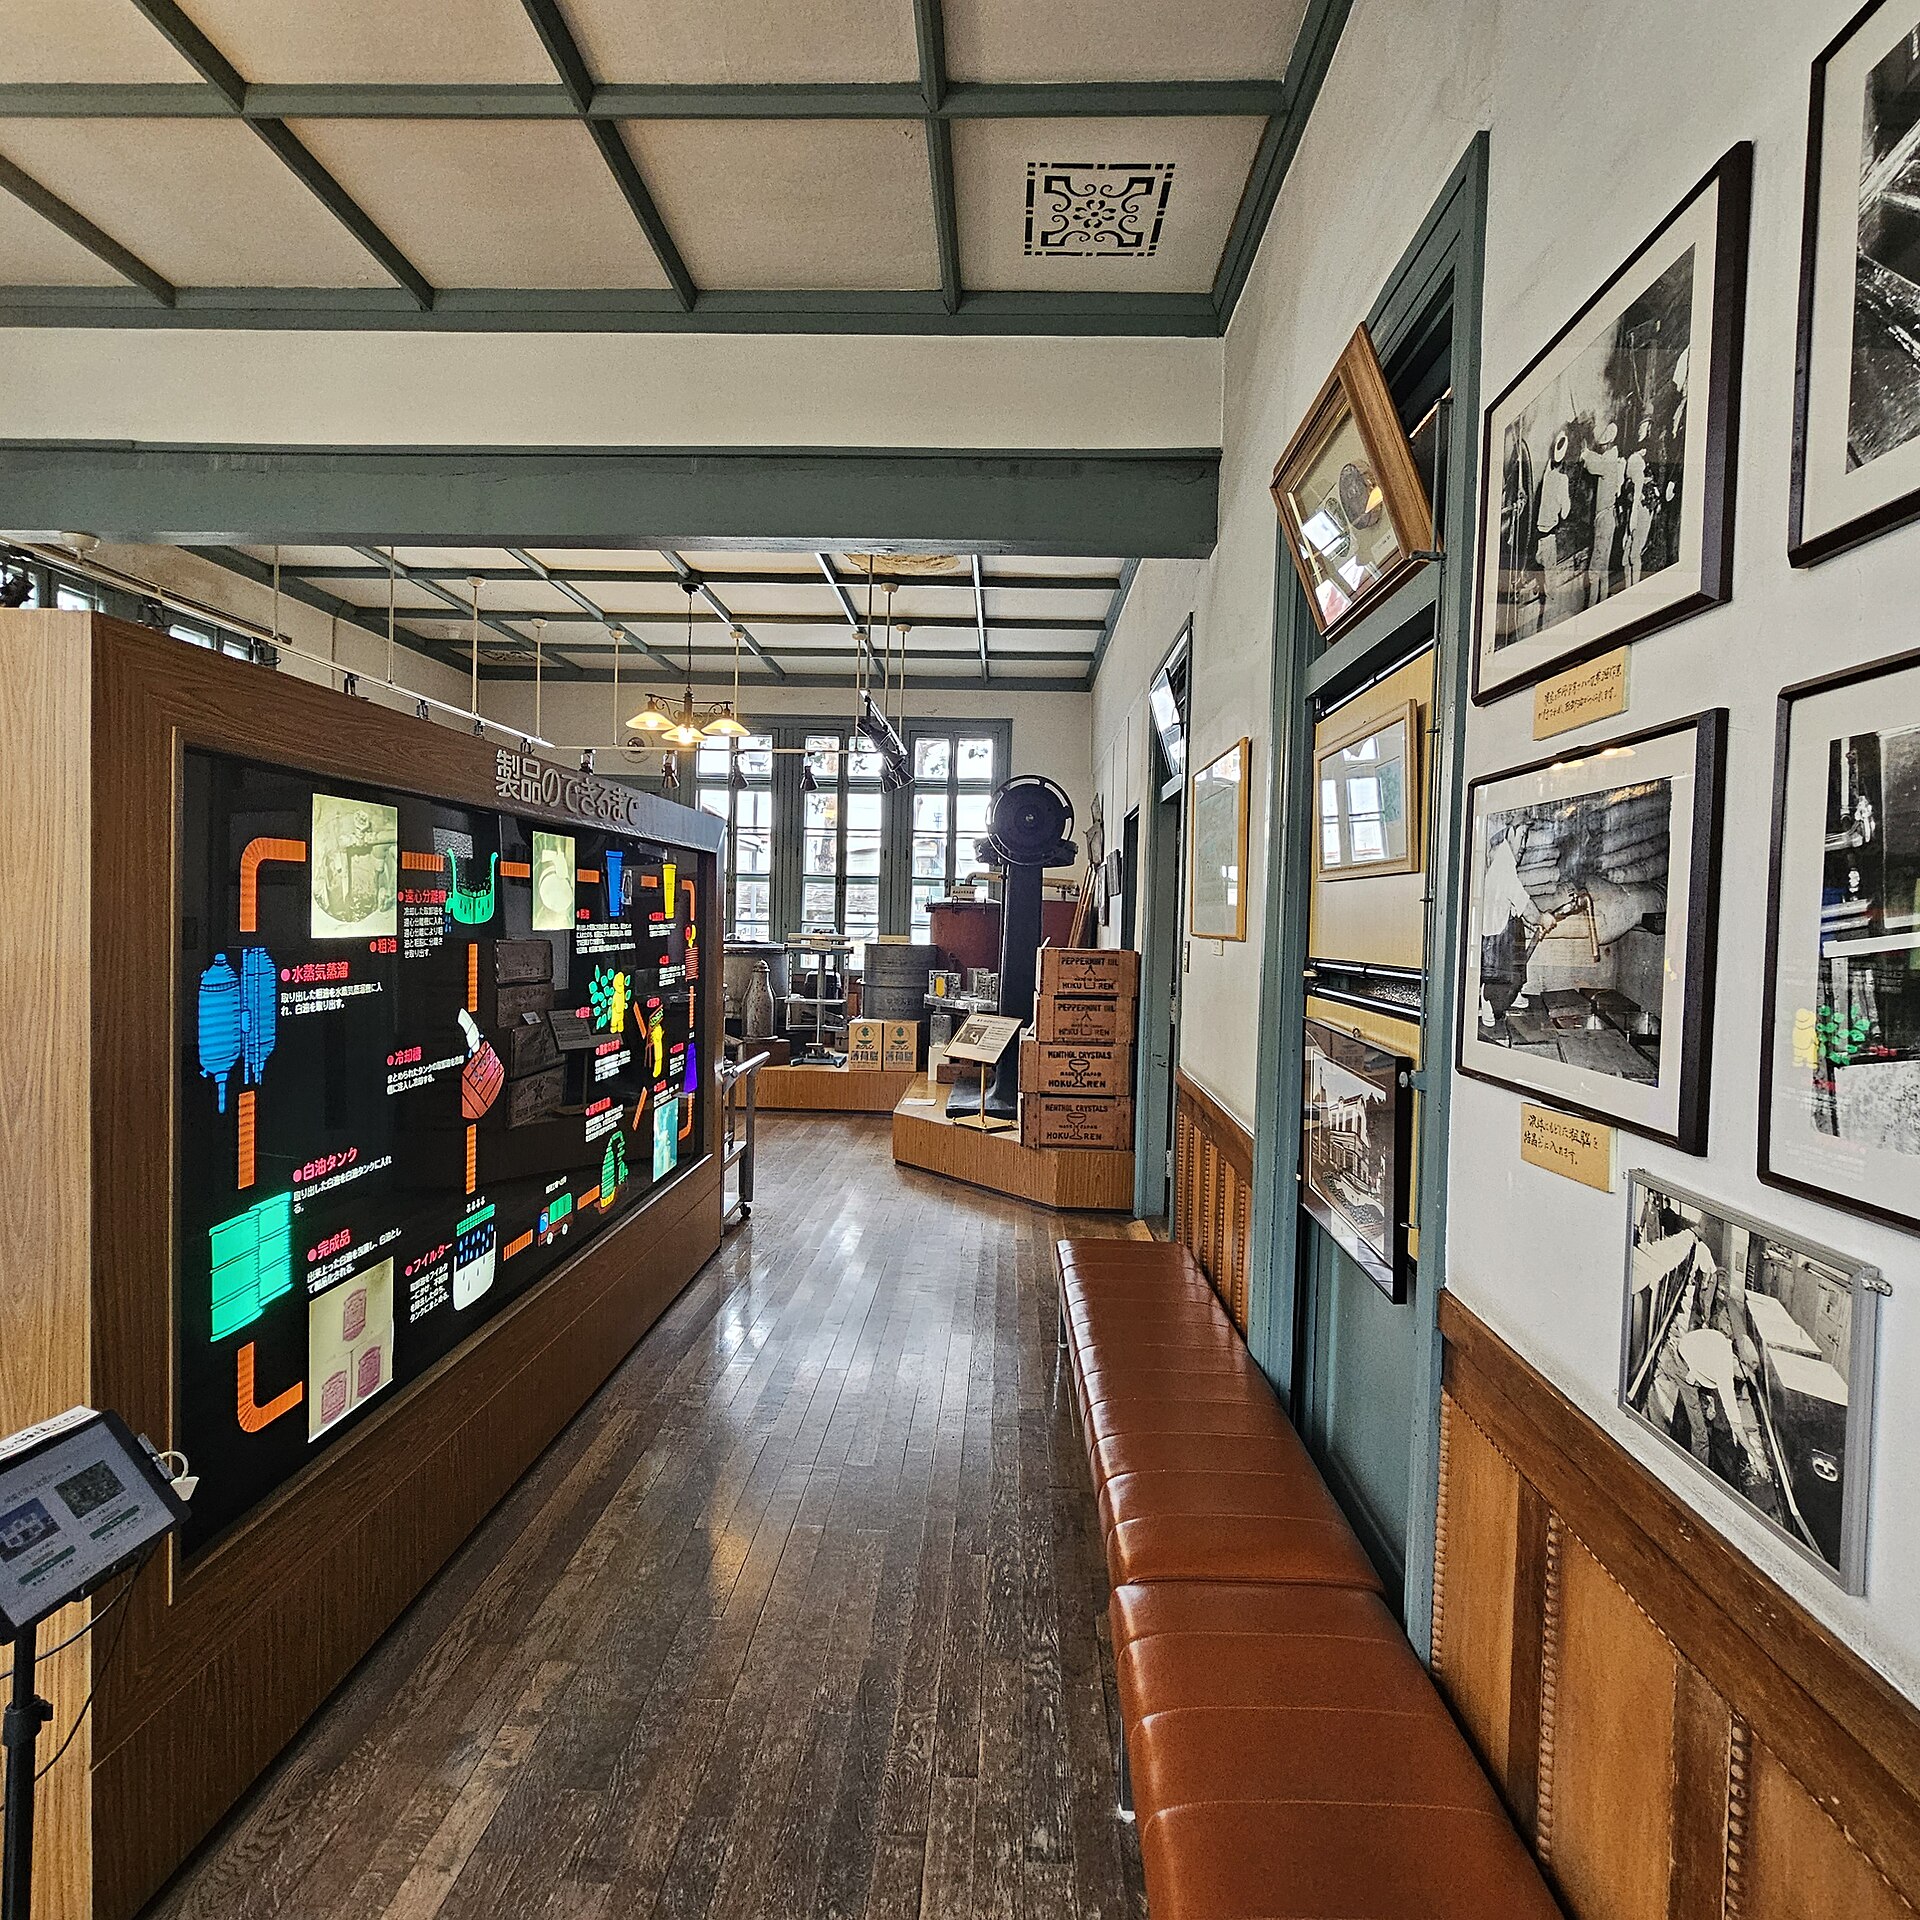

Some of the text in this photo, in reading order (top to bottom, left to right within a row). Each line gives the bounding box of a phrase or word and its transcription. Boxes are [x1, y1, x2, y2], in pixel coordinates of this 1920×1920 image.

[495, 749, 639, 825] 製品のできるまで
[377, 937, 397, 953] 粗油
[1061, 956, 1119, 966] PEPPERMINT OIL
[1062, 981, 1114, 990] HOKU REN
[1057, 1003, 1101, 1012] PEPPERMINT
[1058, 1027, 1079, 1036] HOKU
[1047, 1050, 1112, 1060] MENTHOL CRYSTALS
[1048, 1079, 1107, 1088] HOKU REN
[1045, 1103, 1108, 1113] MENTHOL CRYSTALS
[1046, 1131, 1102, 1140] HOKU REN
[303, 1147, 358, 1181] 白油タンク
[293, 1203, 304, 1214] る。
[317, 1228, 351, 1260] 完成品
